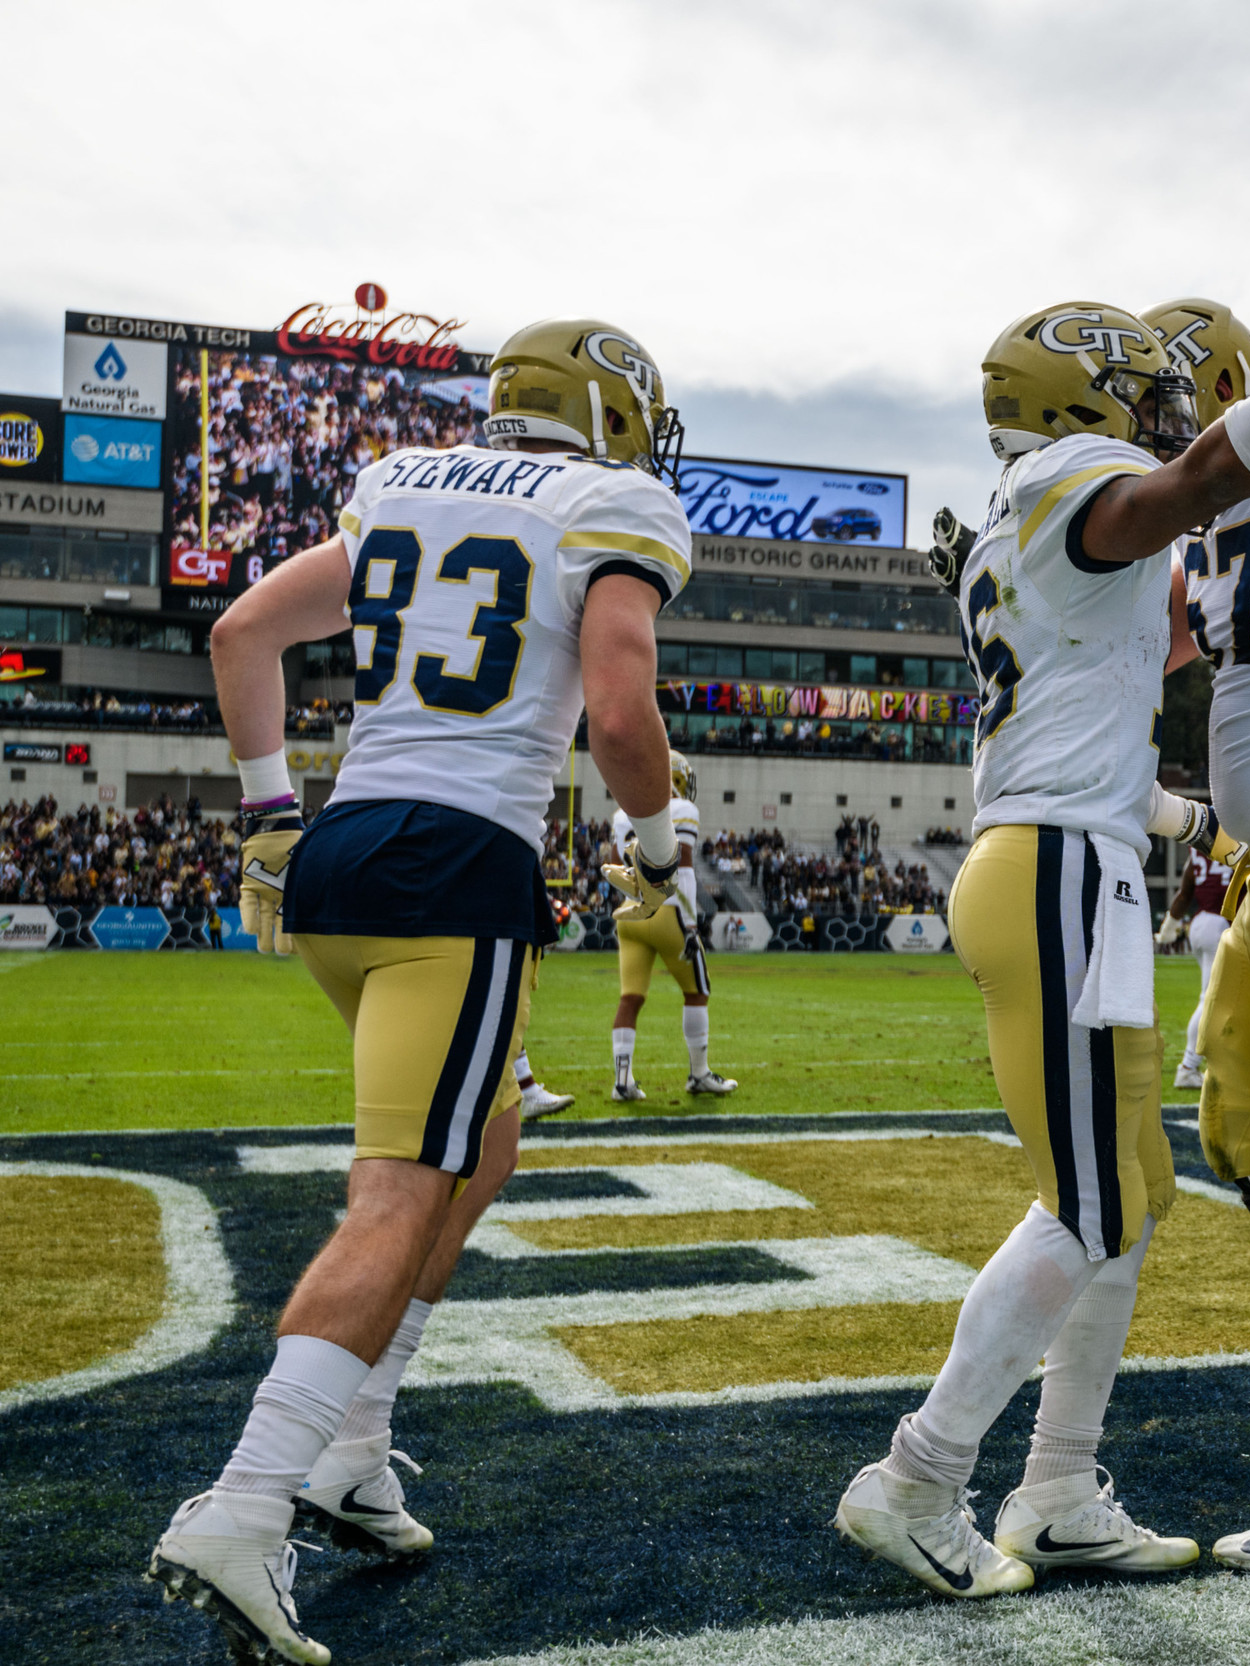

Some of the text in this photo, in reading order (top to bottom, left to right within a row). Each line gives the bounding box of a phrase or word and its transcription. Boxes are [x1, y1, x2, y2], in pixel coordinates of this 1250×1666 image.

[86, 315, 250, 348] GEORGIA TECH
[274, 303, 468, 370] Coca-Cola
[1040, 313, 1144, 365] GT
[1153, 319, 1214, 369] T
[585, 331, 661, 402] GT
[69, 396, 157, 415] Natural Gas
[81, 382, 140, 400] Georgia
[0, 419, 38, 443] ORE
[0, 441, 38, 462] OWER
[103, 441, 155, 463] AT&T
[382, 454, 564, 499] STEWART
[0, 491, 105, 516] TADIUM
[678, 467, 820, 540] Ford
[750, 490, 789, 503] ESCAPE
[178, 550, 226, 582] GT
[701, 545, 933, 577] HISTORIC GRANT FIEL
[346, 524, 536, 719] 83
[680, 683, 819, 717] YELLOW
[1113, 893, 1140, 906] RUSSELL
